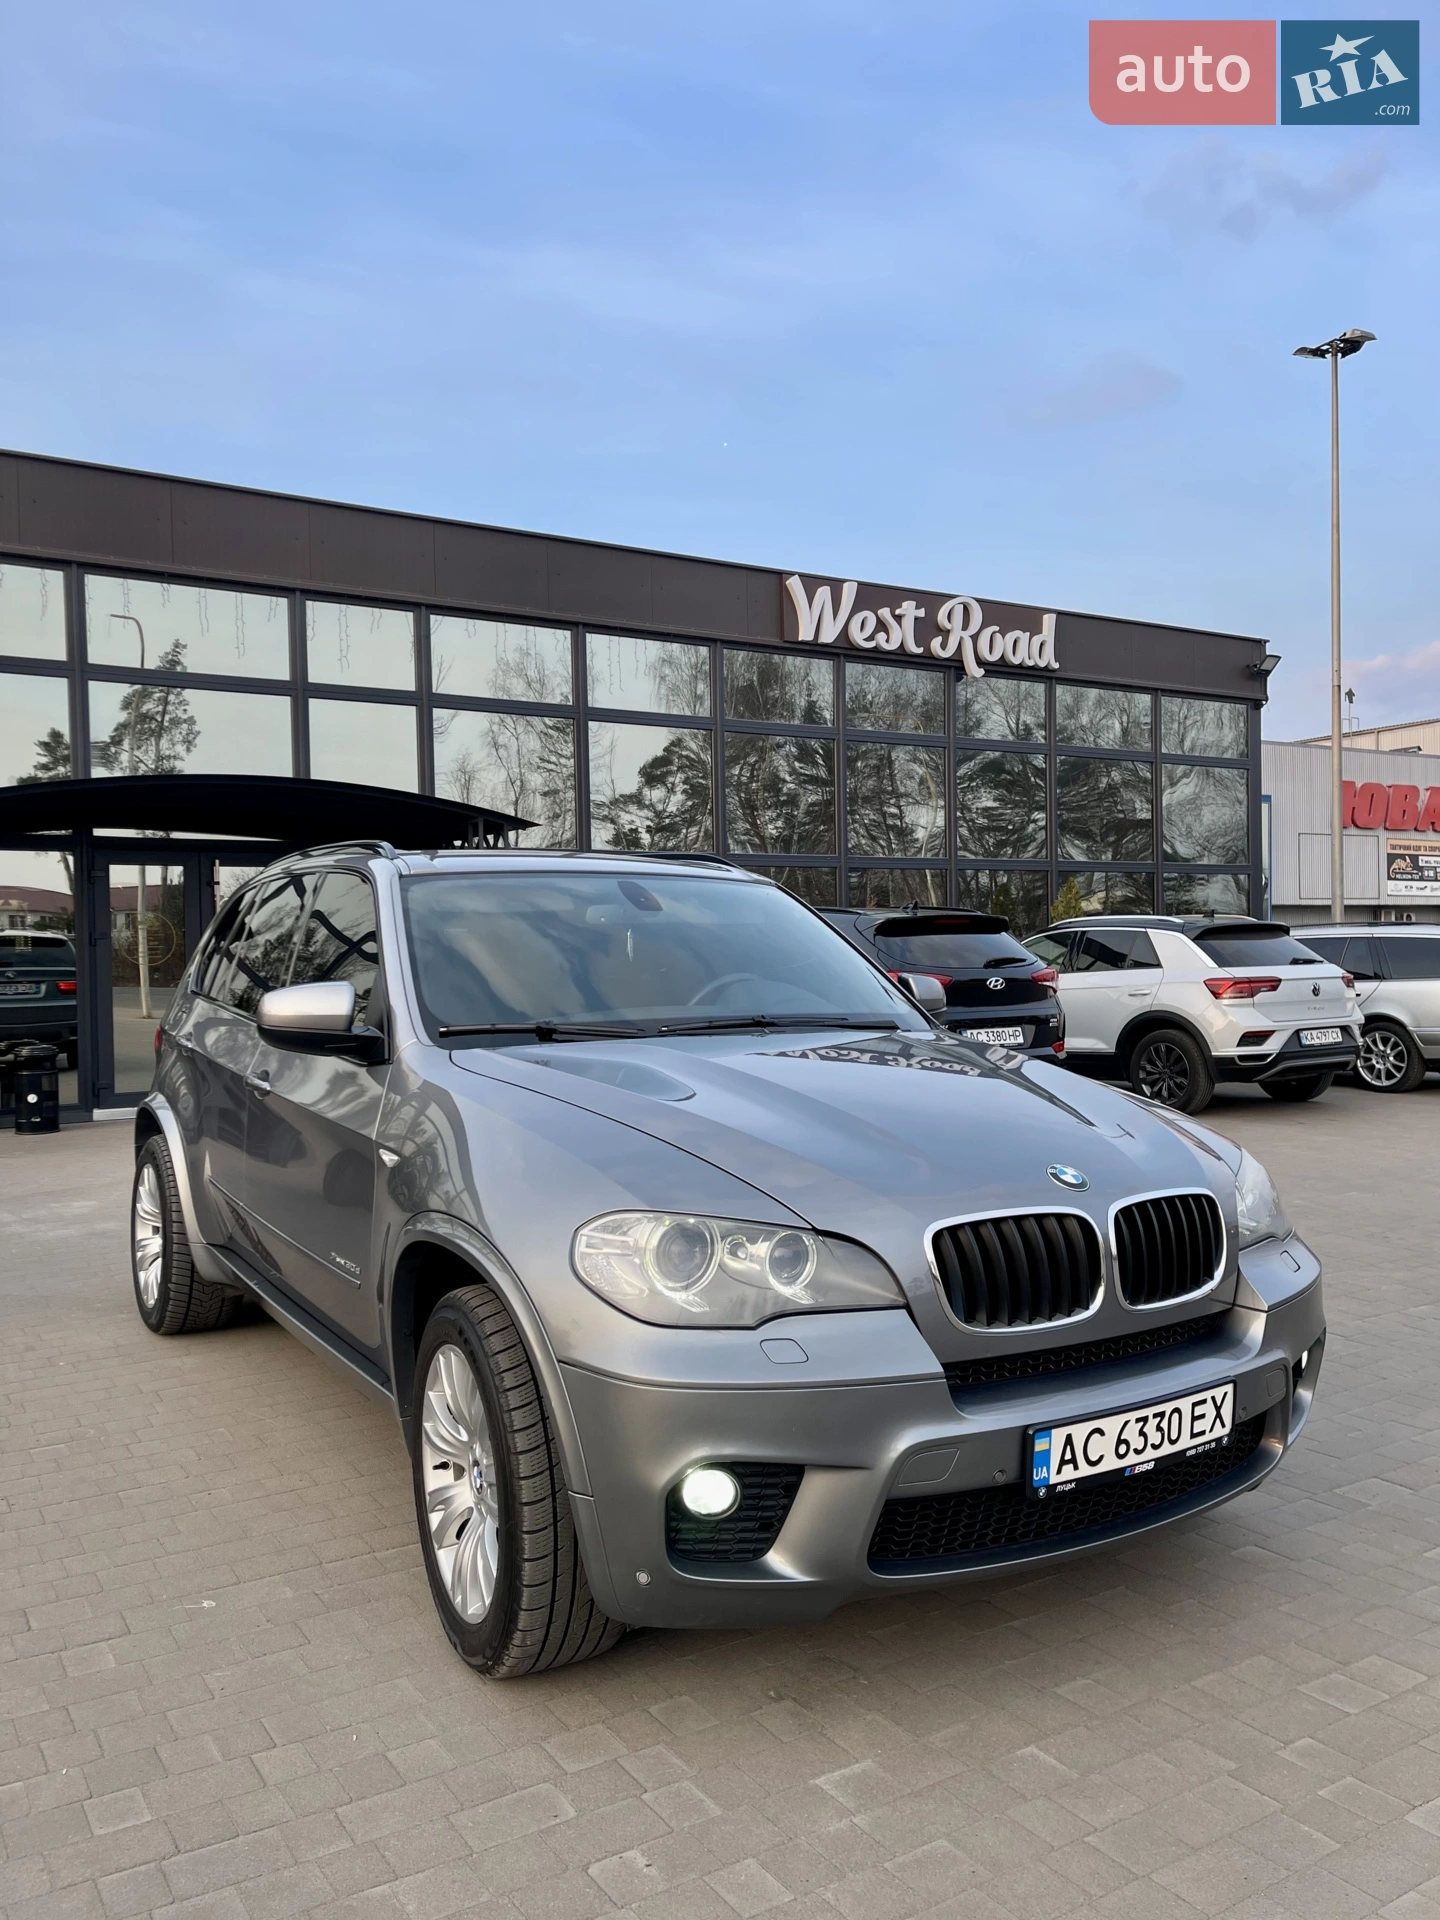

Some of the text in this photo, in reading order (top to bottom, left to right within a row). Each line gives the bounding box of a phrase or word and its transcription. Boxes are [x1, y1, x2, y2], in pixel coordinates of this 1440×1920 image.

[786, 574, 1060, 678] West Road
[984, 1030, 1007, 1042] 3380
[1008, 1030, 1021, 1041] HP
[1304, 1030, 1341, 1042] KA 4797 CX
[1056, 1390, 1229, 1476] AC 6330 EX
[1033, 1466, 1048, 1480] UA
[1055, 1481, 1077, 1493] ЛУЦЬК
